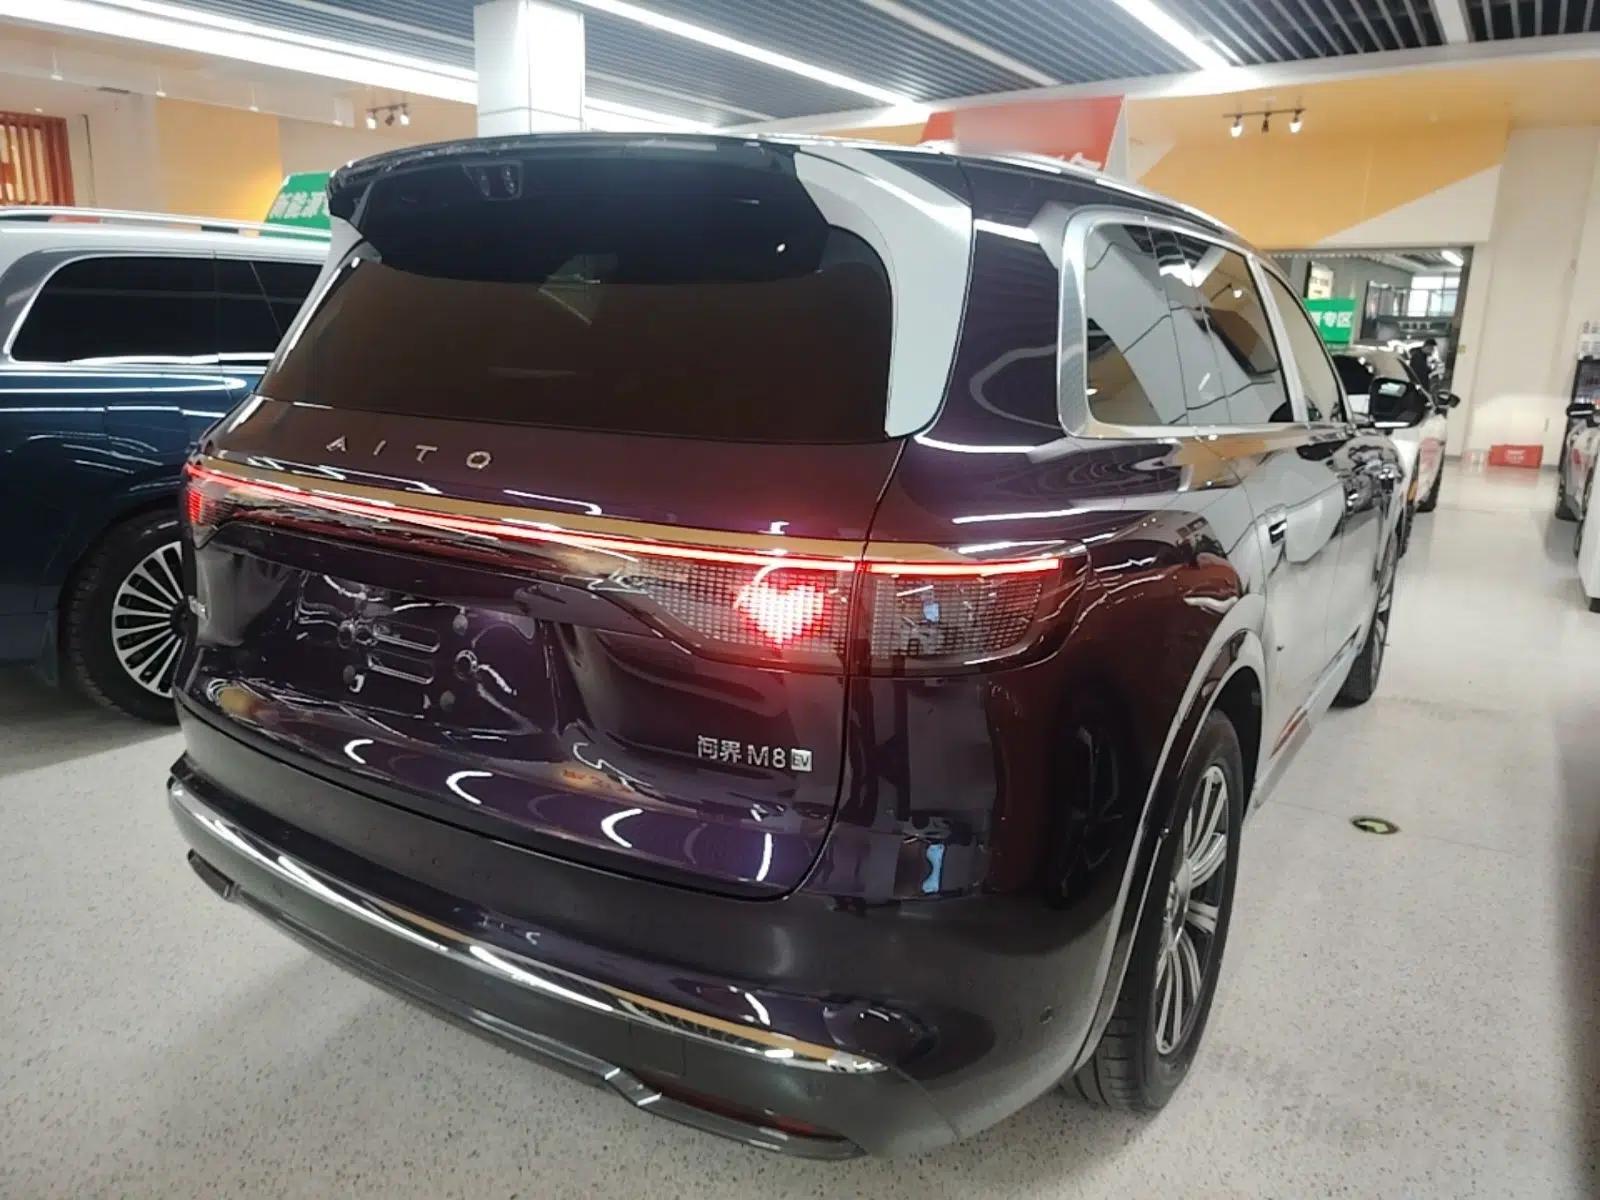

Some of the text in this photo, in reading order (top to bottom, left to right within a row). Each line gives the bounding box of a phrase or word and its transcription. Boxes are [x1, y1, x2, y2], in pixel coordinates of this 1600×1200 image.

[326, 435, 492, 469] AITO
[697, 735, 811, 769] 问界 M8 EV
